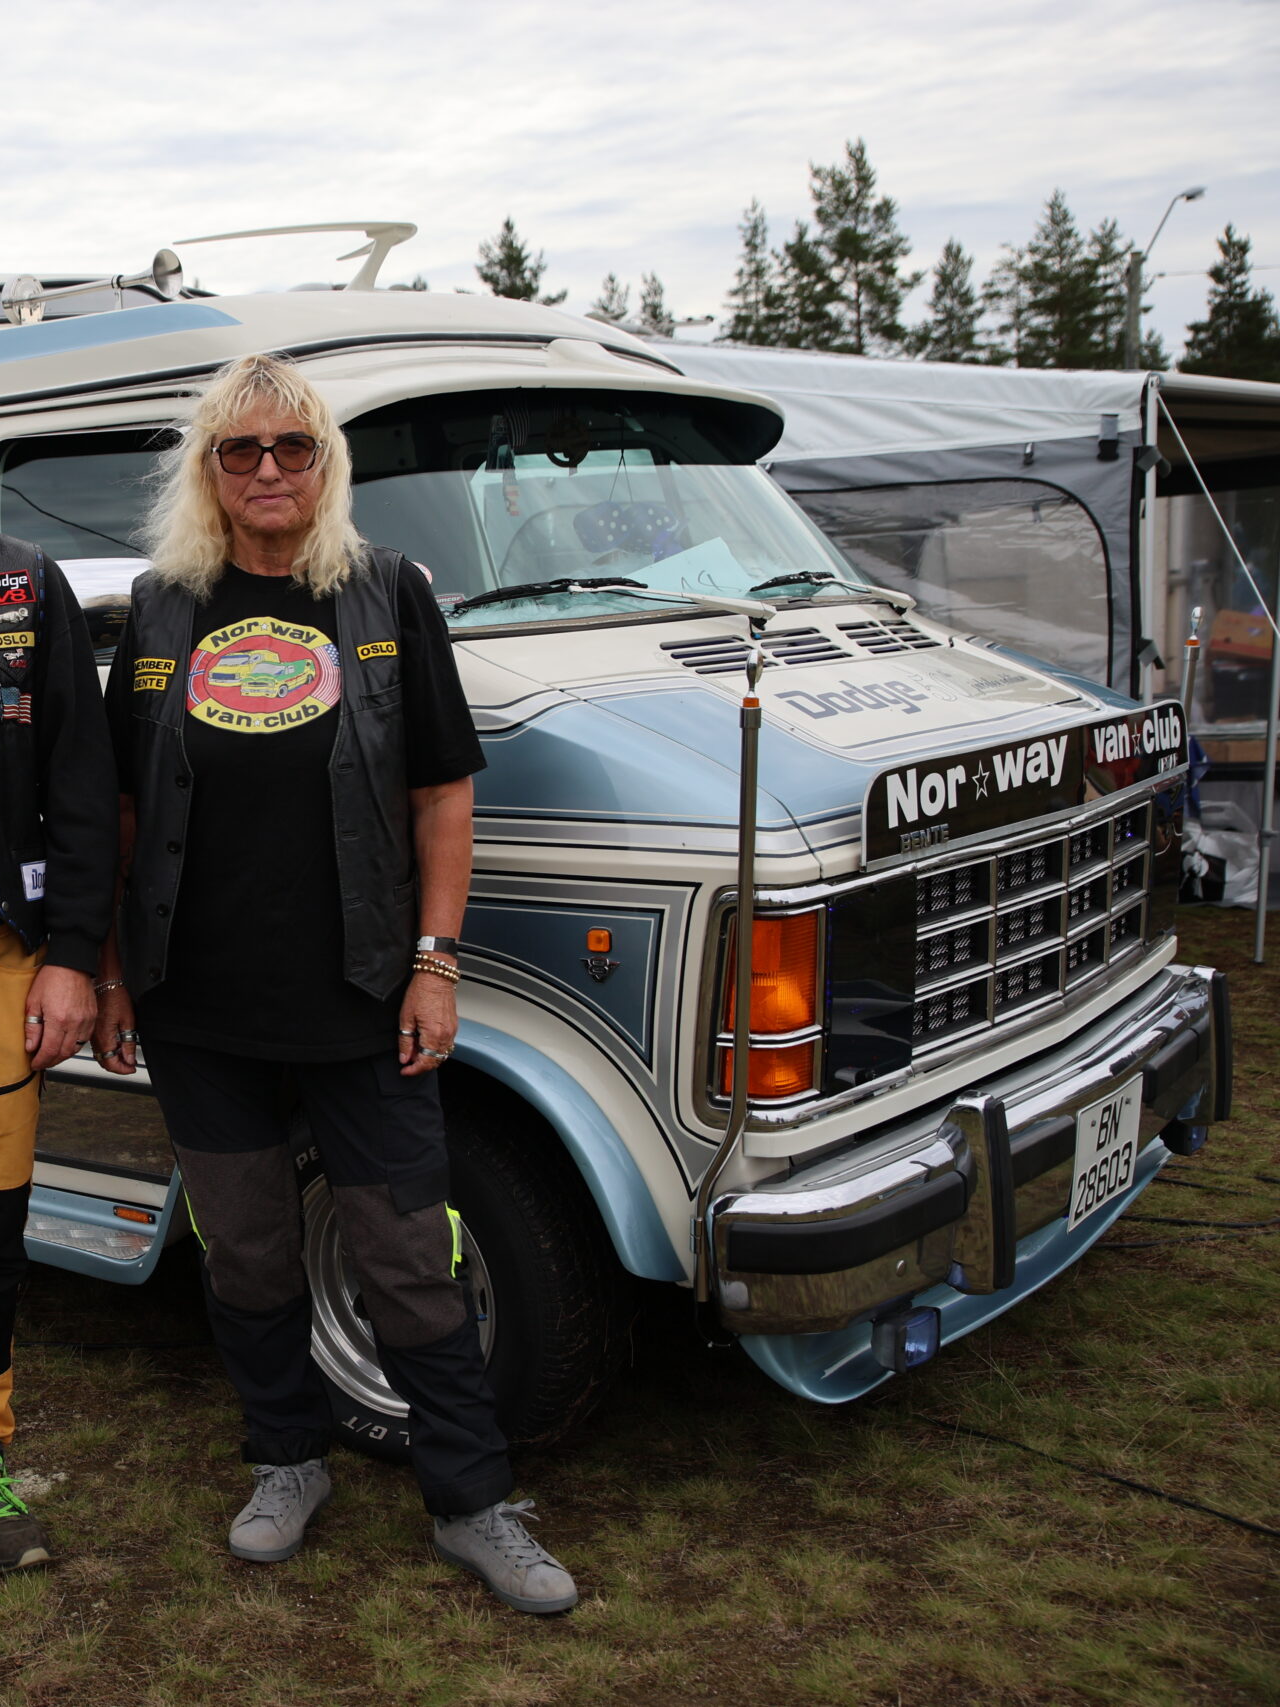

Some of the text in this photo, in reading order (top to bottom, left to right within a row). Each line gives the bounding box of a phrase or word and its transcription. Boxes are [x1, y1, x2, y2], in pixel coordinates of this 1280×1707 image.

[209, 620, 318, 648] Nor way
[360, 643, 394, 657] OSLO
[206, 703, 320, 728] van club
[773, 680, 930, 720] Dodge
[886, 764, 966, 829] Nor
[992, 734, 1068, 793] way
[1093, 723, 1131, 764] van
[1142, 707, 1181, 755] club
[900, 823, 950, 854] BENTE
[1096, 1095, 1124, 1152] BN
[1074, 1140, 1133, 1223] 28603
[341, 1415, 389, 1441] G/T
